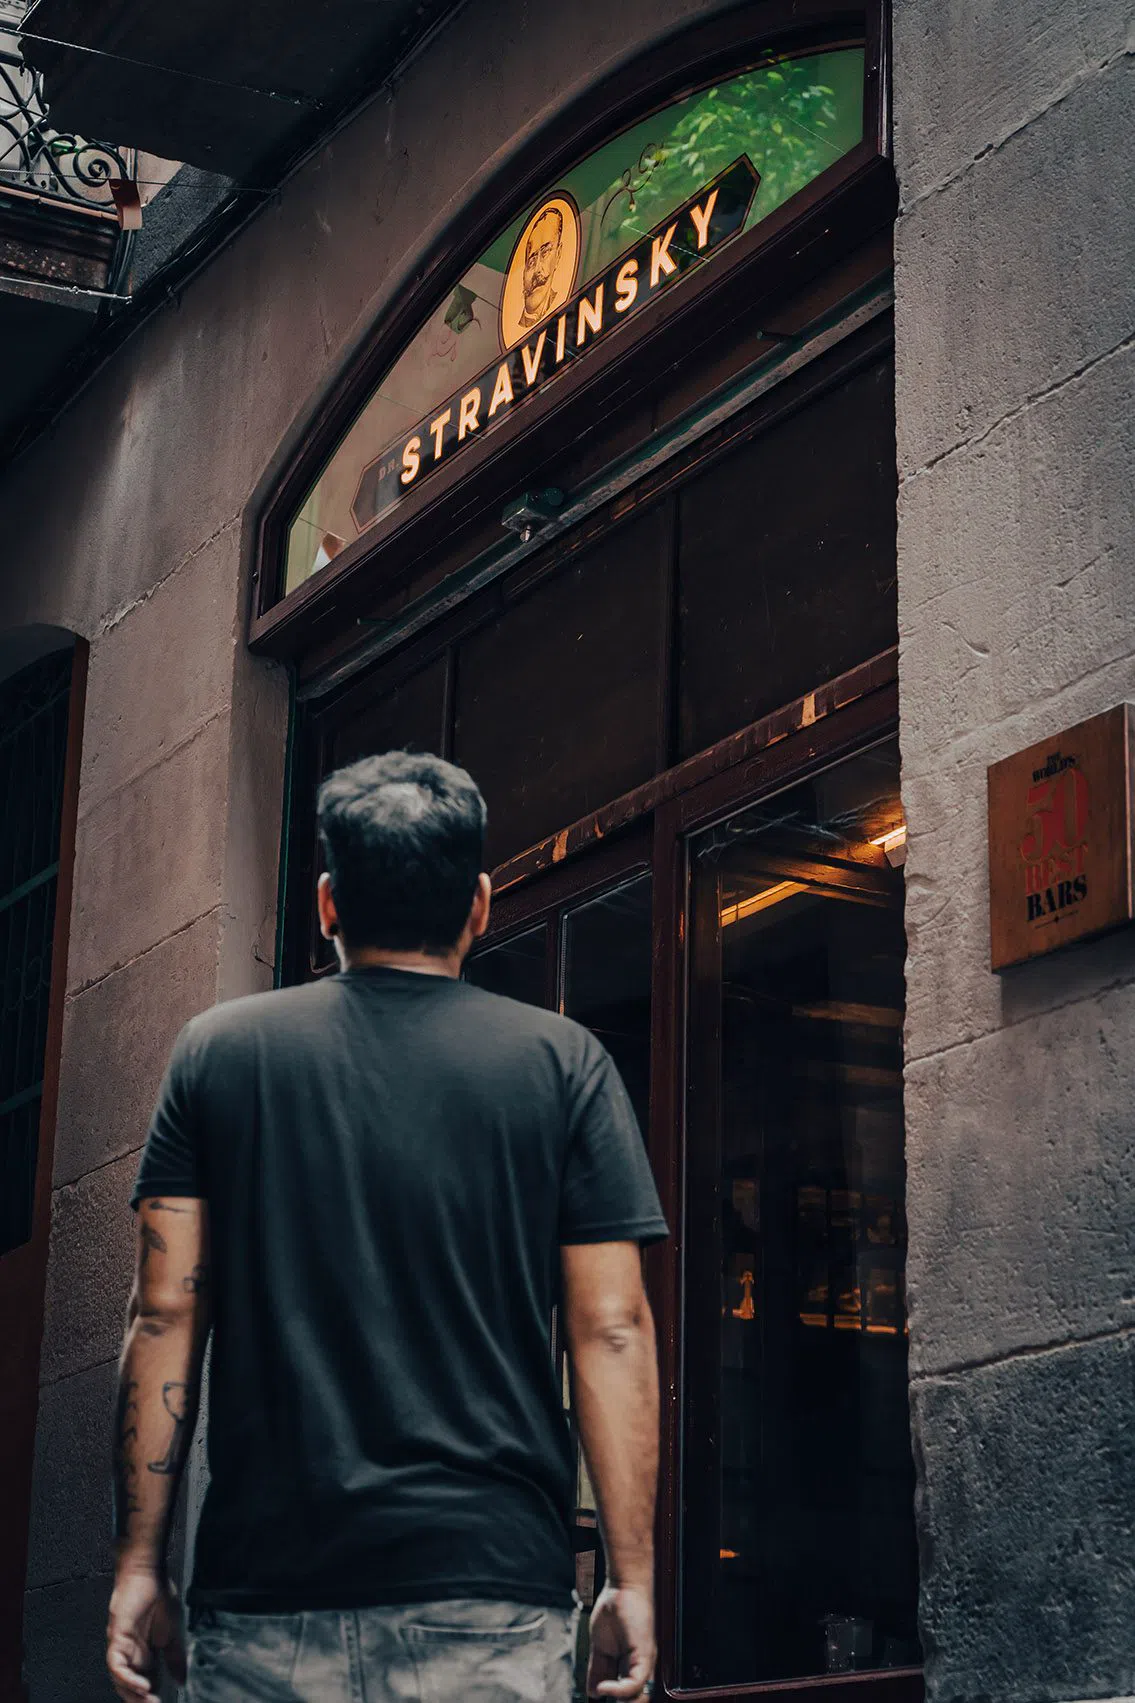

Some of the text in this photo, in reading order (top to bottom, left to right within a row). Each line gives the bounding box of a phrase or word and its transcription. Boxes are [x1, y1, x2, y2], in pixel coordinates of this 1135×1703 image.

[401, 189, 719, 485] STRAVINSKY
[1021, 768, 1089, 863] 50
[1026, 874, 1087, 922] BARS
